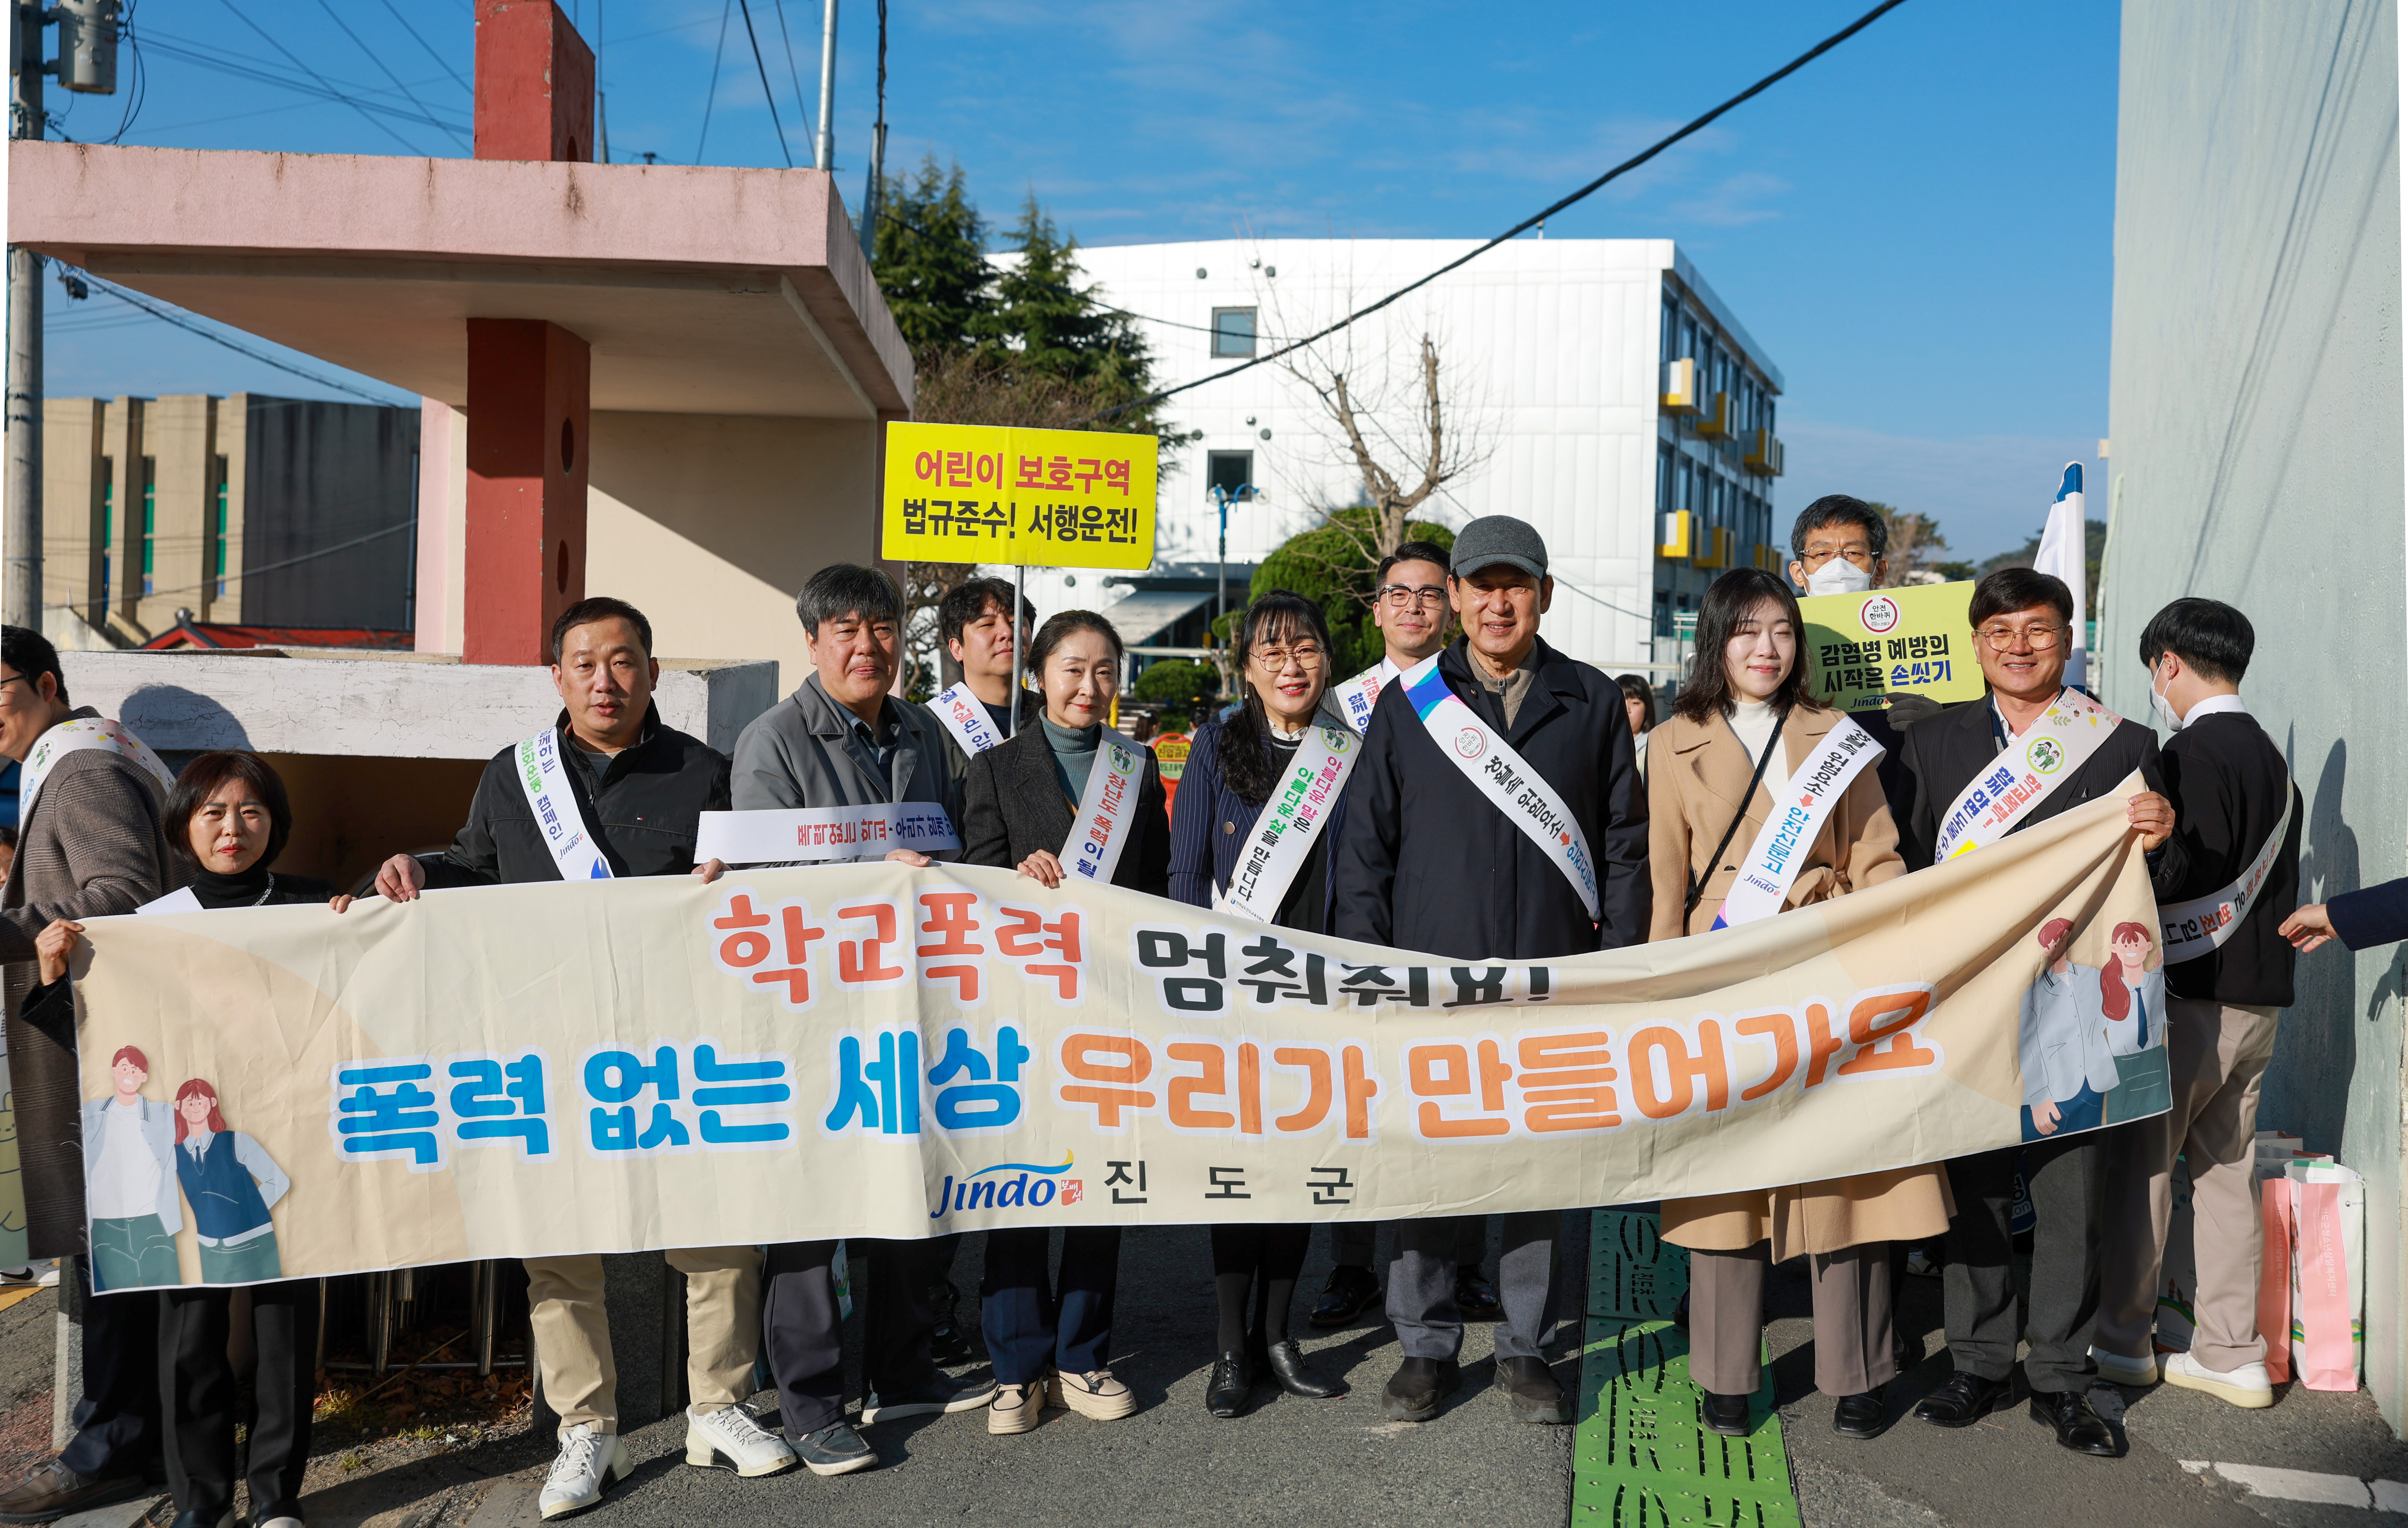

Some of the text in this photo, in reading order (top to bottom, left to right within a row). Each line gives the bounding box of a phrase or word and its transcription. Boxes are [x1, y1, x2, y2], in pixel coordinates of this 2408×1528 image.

[915, 450, 1130, 496] 어린이 보호구역
[903, 498, 1137, 544] 법규준수! 서행운전!
[1869, 611, 1891, 620] 한바퀴
[1820, 634, 1949, 667] 감염병 예방의
[1824, 660, 1952, 693] 시작은 손씻기
[1348, 692, 1368, 714] 함께
[1850, 696, 1884, 708] Jindo
[1458, 731, 1470, 744] 안전
[1462, 734, 1479, 752] 한바퀴
[1098, 771, 1127, 817] 장난도
[1276, 766, 1315, 819] 아름다운
[1293, 756, 1343, 833] 아름다운 말은
[1484, 754, 1525, 796] 생활속
[1517, 787, 1566, 839] 위험요소
[1803, 751, 1850, 797] 위험요소
[1984, 766, 2016, 798] 함께
[536, 794, 564, 841] 캠페인
[1962, 788, 1991, 820] 하면
[1982, 772, 2044, 829] 학교폭력!
[559, 836, 579, 860] Jindo
[896, 815, 925, 839] 우리가
[927, 814, 945, 837] 함께
[1084, 813, 1113, 861] 폭력이
[1261, 818, 1288, 848] 삶을
[1761, 806, 1811, 876] 안전신문고
[1237, 845, 1271, 902] 만듭니다
[1743, 874, 1775, 894] Jindo
[714, 891, 1550, 1011] 학교폭력 멈춰줘요!
[338, 991, 1934, 1164] 폭력 없는 세상 우리가 만들어가요
[930, 1172, 1056, 1219] Jindo
[2321, 1206, 2337, 1296] 진도군청소년상담복지센터
